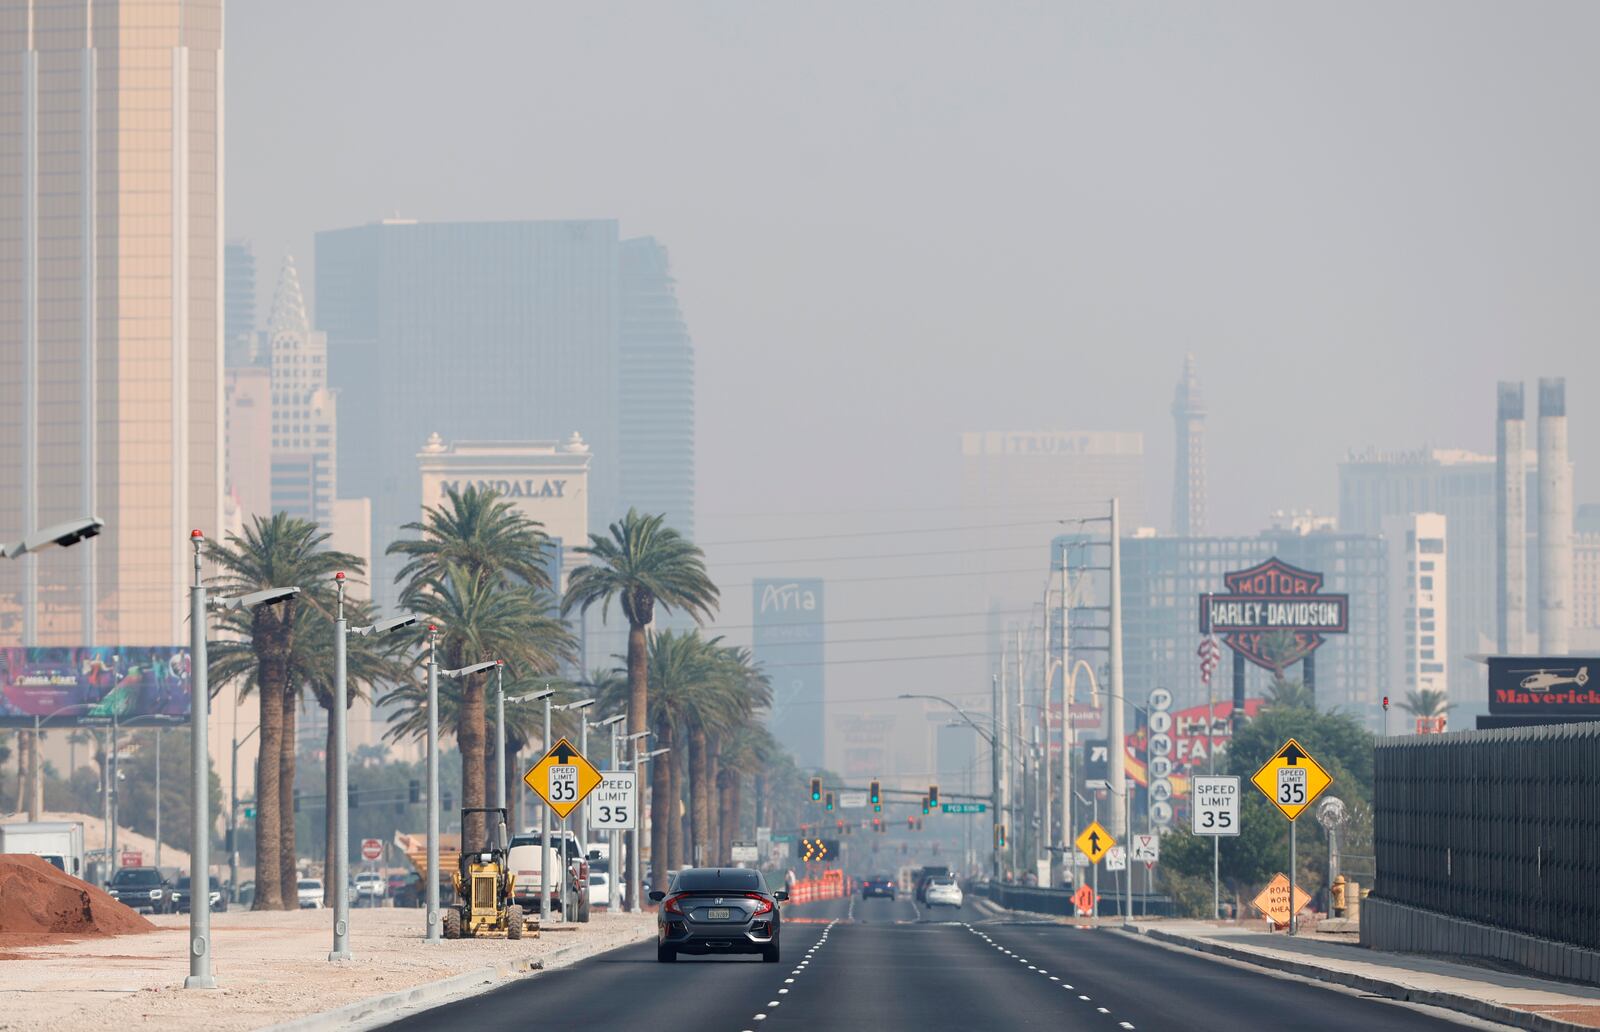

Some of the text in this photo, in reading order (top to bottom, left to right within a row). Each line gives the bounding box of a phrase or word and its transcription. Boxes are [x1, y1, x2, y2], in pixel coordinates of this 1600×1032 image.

[1010, 436, 1089, 452] TRUMP
[1239, 569, 1307, 594] MOTOR
[760, 583, 816, 612] Aria
[1280, 769, 1305, 777] SPEED
[552, 781, 576, 801] 35
[598, 792, 628, 801] LIMIT
[1197, 784, 1236, 795] SPEED
[1280, 783, 1305, 803] 35
[1201, 797, 1232, 807] LIMIT
[598, 806, 628, 823] 35
[1202, 811, 1232, 828] 35
